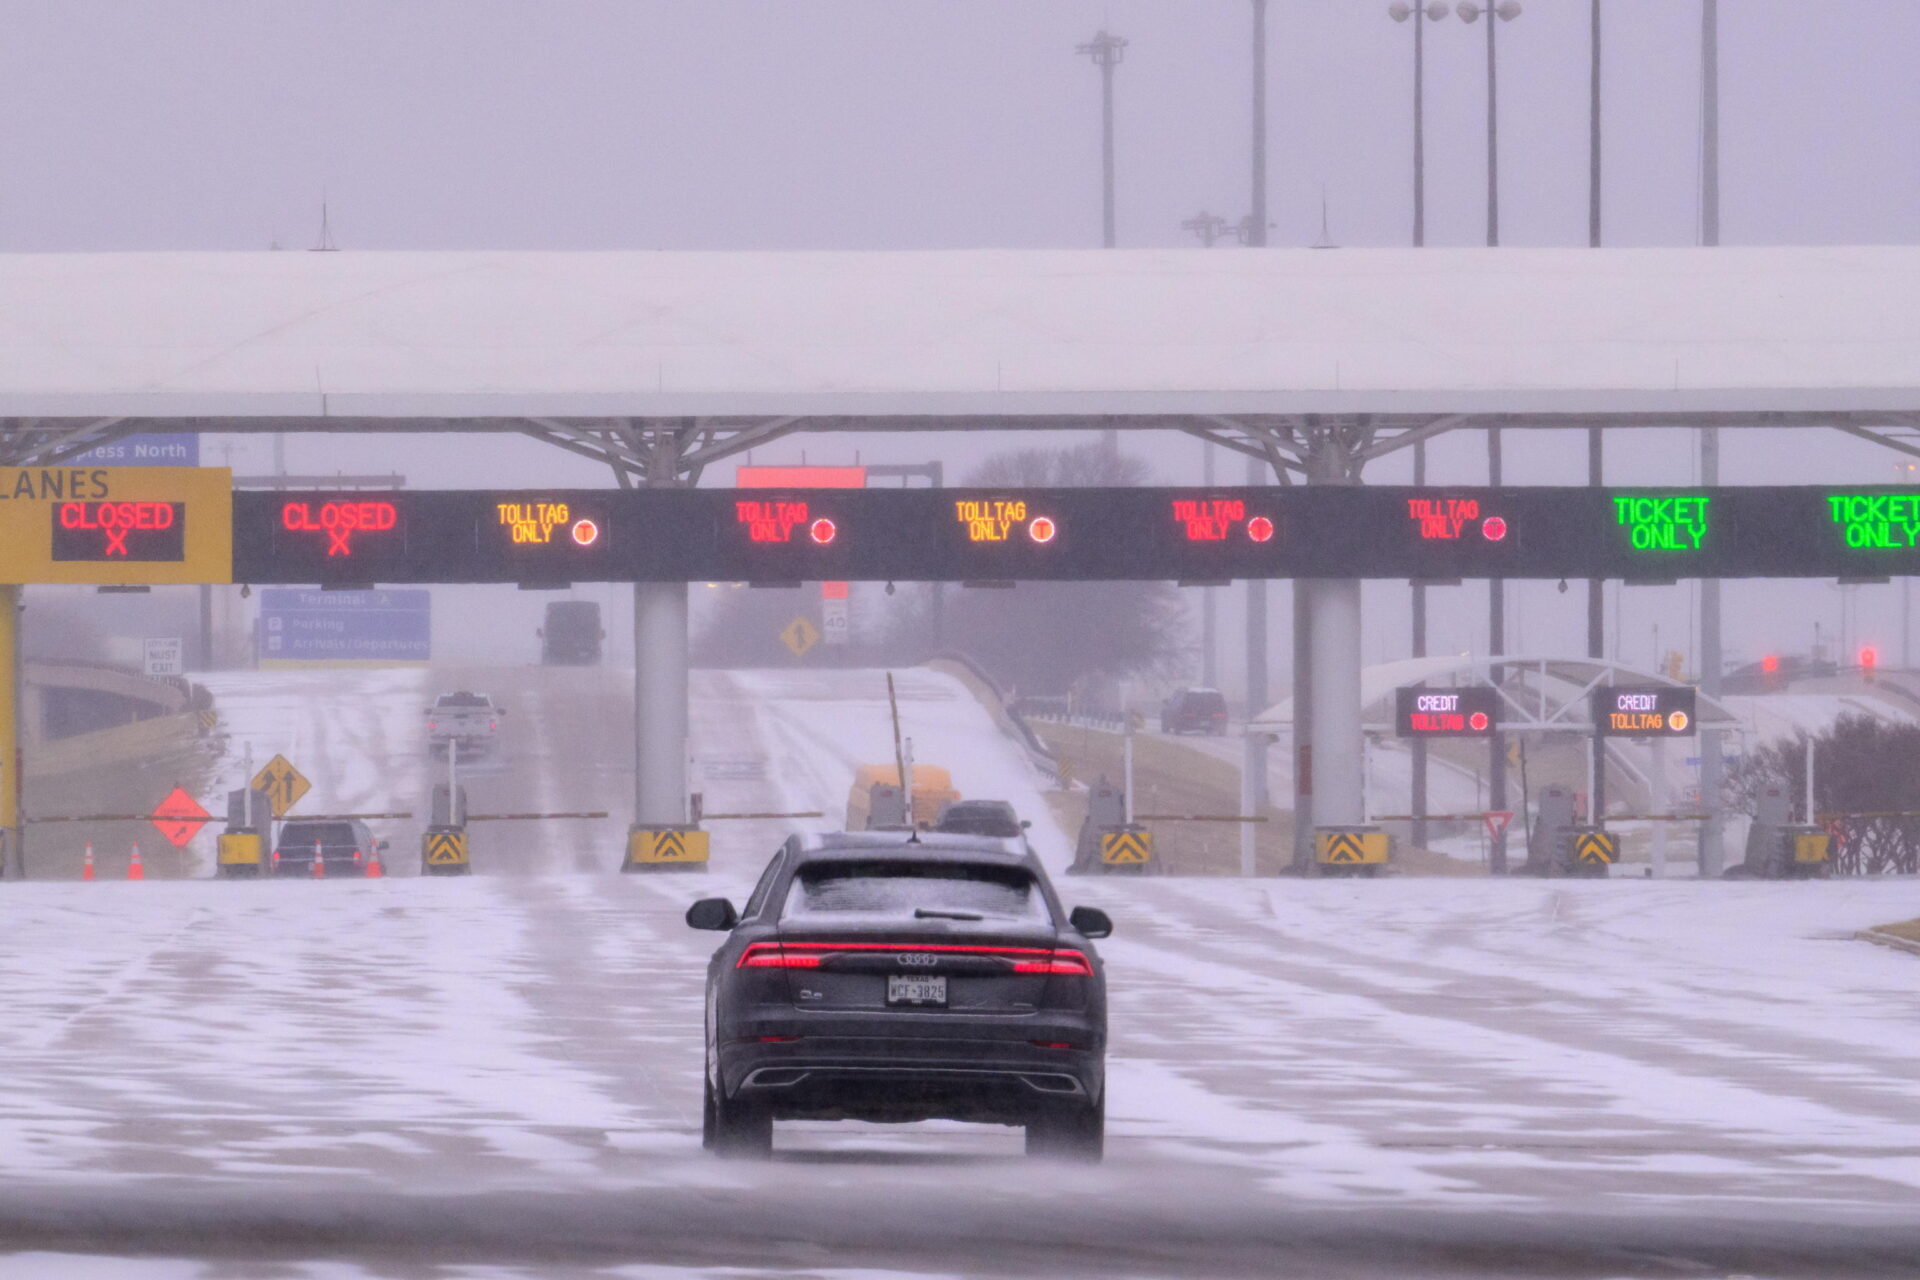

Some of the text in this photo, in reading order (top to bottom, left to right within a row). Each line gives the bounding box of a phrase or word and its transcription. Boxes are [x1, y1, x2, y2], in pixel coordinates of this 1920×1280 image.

[56, 444, 187, 461] Epress North
[60, 502, 174, 529] CLOSED
[282, 502, 397, 530] CLOSED
[1613, 497, 1710, 524] TICKET
[1826, 495, 1920, 523] TICKET
[512, 523, 553, 543] ONLY
[750, 520, 793, 542] ONLY
[969, 520, 1010, 541] ONLY
[1186, 519, 1229, 540] ONLY
[1421, 517, 1464, 538] ONLY
[1632, 523, 1707, 549] ONLY
[1845, 522, 1920, 548] ONLY
[300, 593, 366, 604] Terminal
[293, 619, 344, 632] Parking
[826, 617, 846, 628] 40
[293, 638, 428, 651] Arrivals/Departures
[149, 650, 176, 660] MUST
[151, 663, 173, 673] EXIT
[1418, 695, 1458, 711] CREDIT
[1618, 694, 1657, 710] CREDIT
